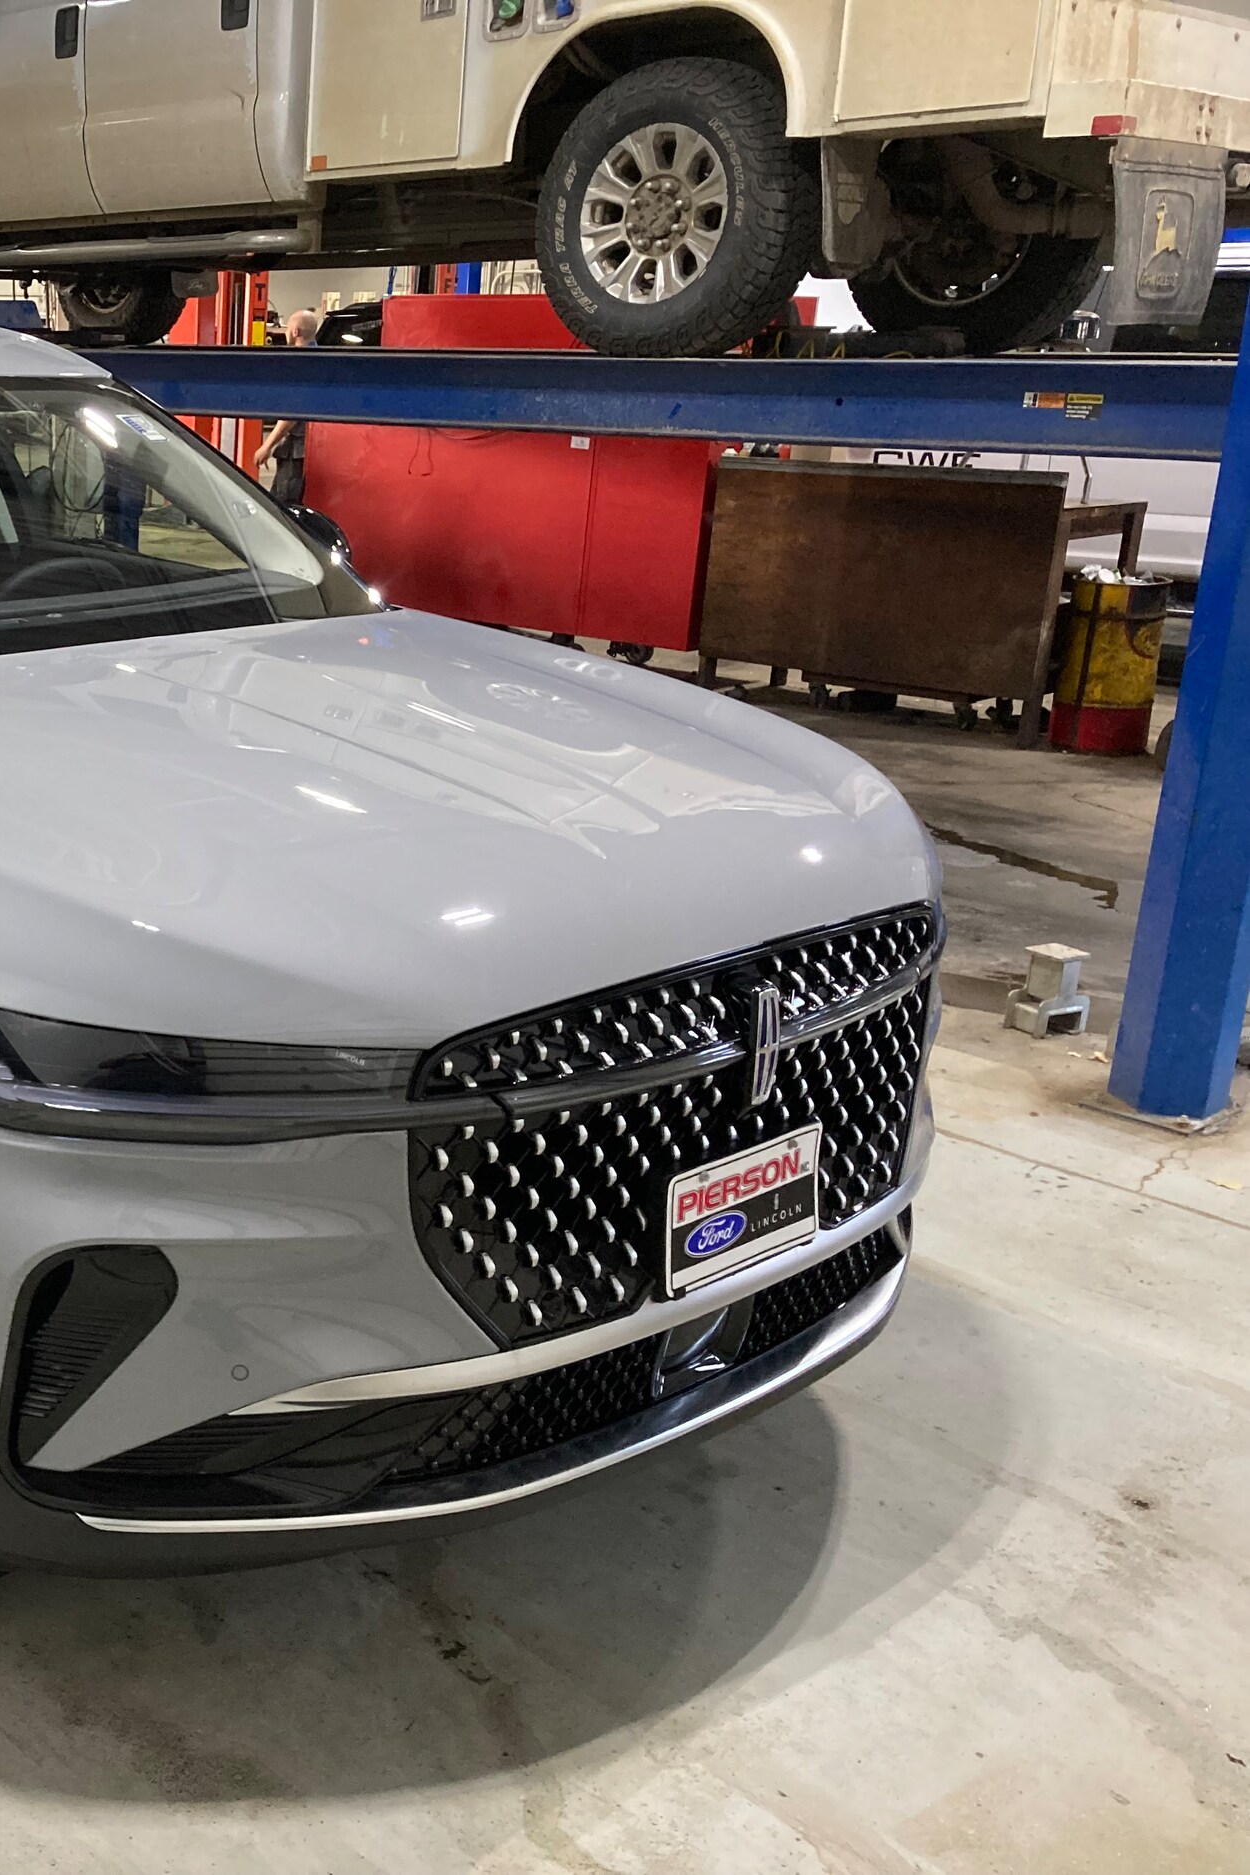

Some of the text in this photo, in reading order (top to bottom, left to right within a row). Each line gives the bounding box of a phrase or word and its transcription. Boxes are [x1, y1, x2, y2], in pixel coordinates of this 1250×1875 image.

[707, 117, 745, 226] HERCULES
[554, 195, 567, 253] TRAC
[559, 262, 598, 314] TERRA
[335, 1050, 366, 1066] LINCOLN
[676, 1148, 802, 1223] PIERSON
[697, 1218, 736, 1251] Ford
[750, 1203, 803, 1232] LINCOLN
